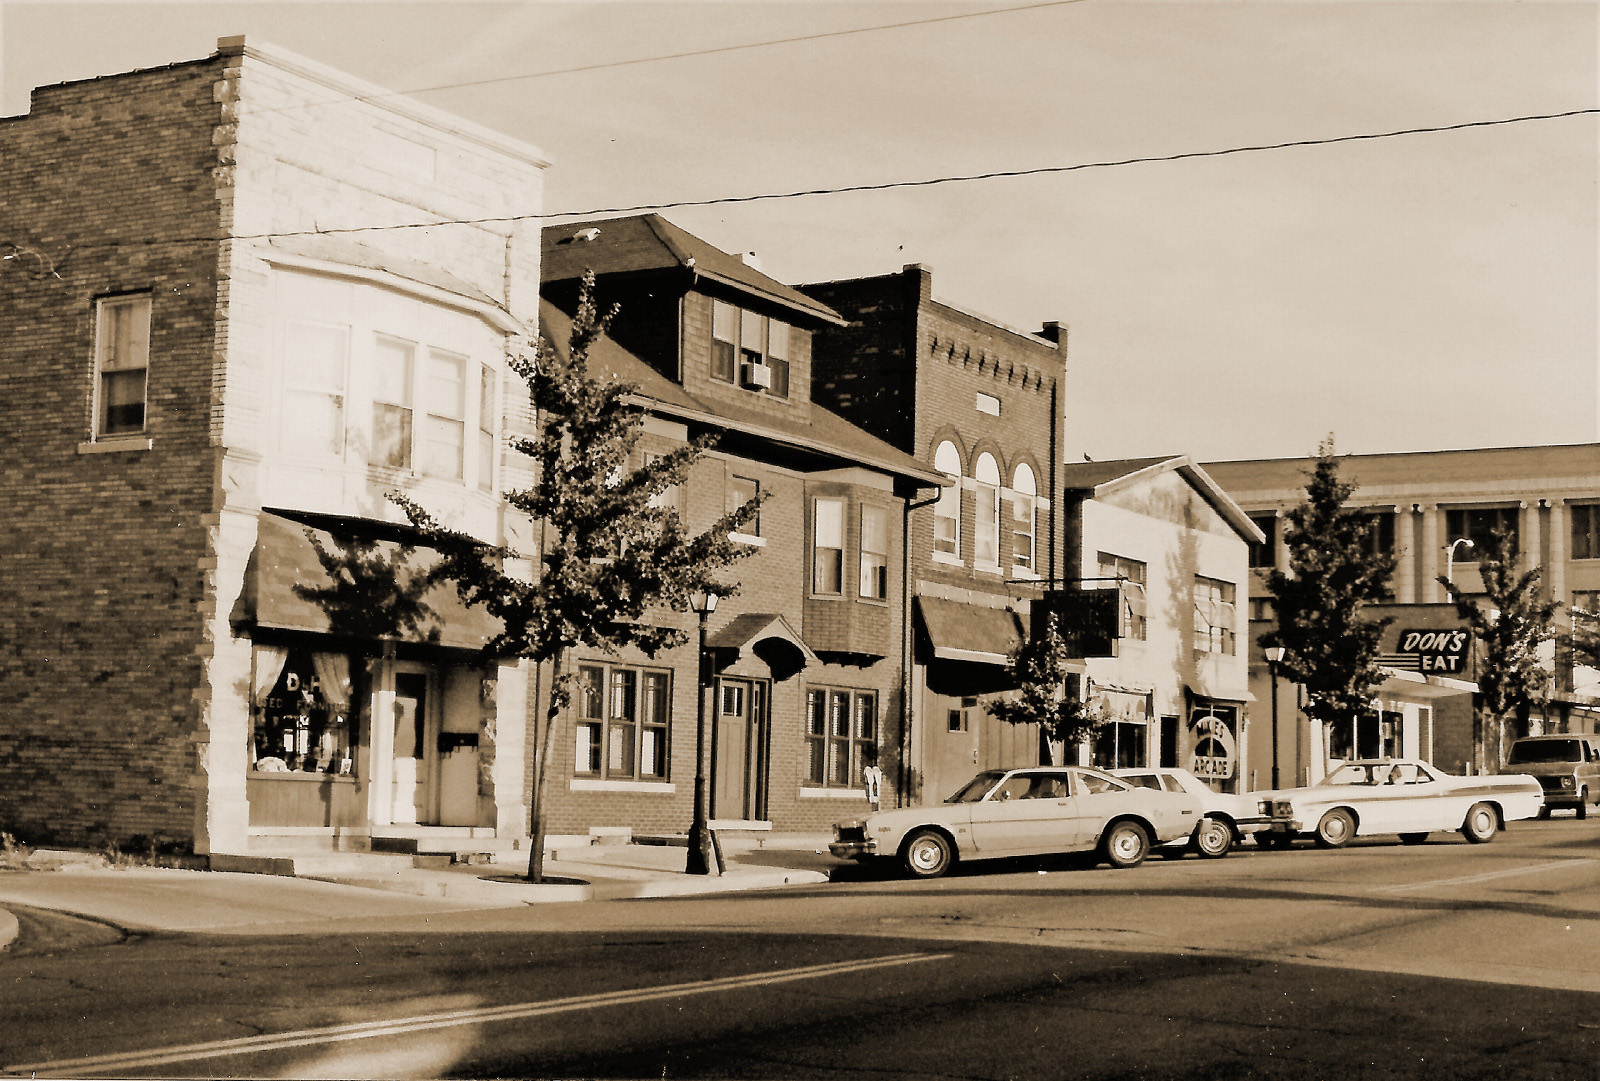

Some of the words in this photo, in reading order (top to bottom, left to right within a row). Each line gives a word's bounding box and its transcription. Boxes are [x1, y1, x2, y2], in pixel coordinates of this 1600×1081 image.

[1403, 630, 1467, 652] DON'S
[1422, 655, 1460, 671] EAT
[286, 672, 300, 692] D
[310, 675, 322, 693] H
[256, 697, 283, 709] USED
[1196, 720, 1224, 739] MIES
[1194, 759, 1228, 775] ARCADE
